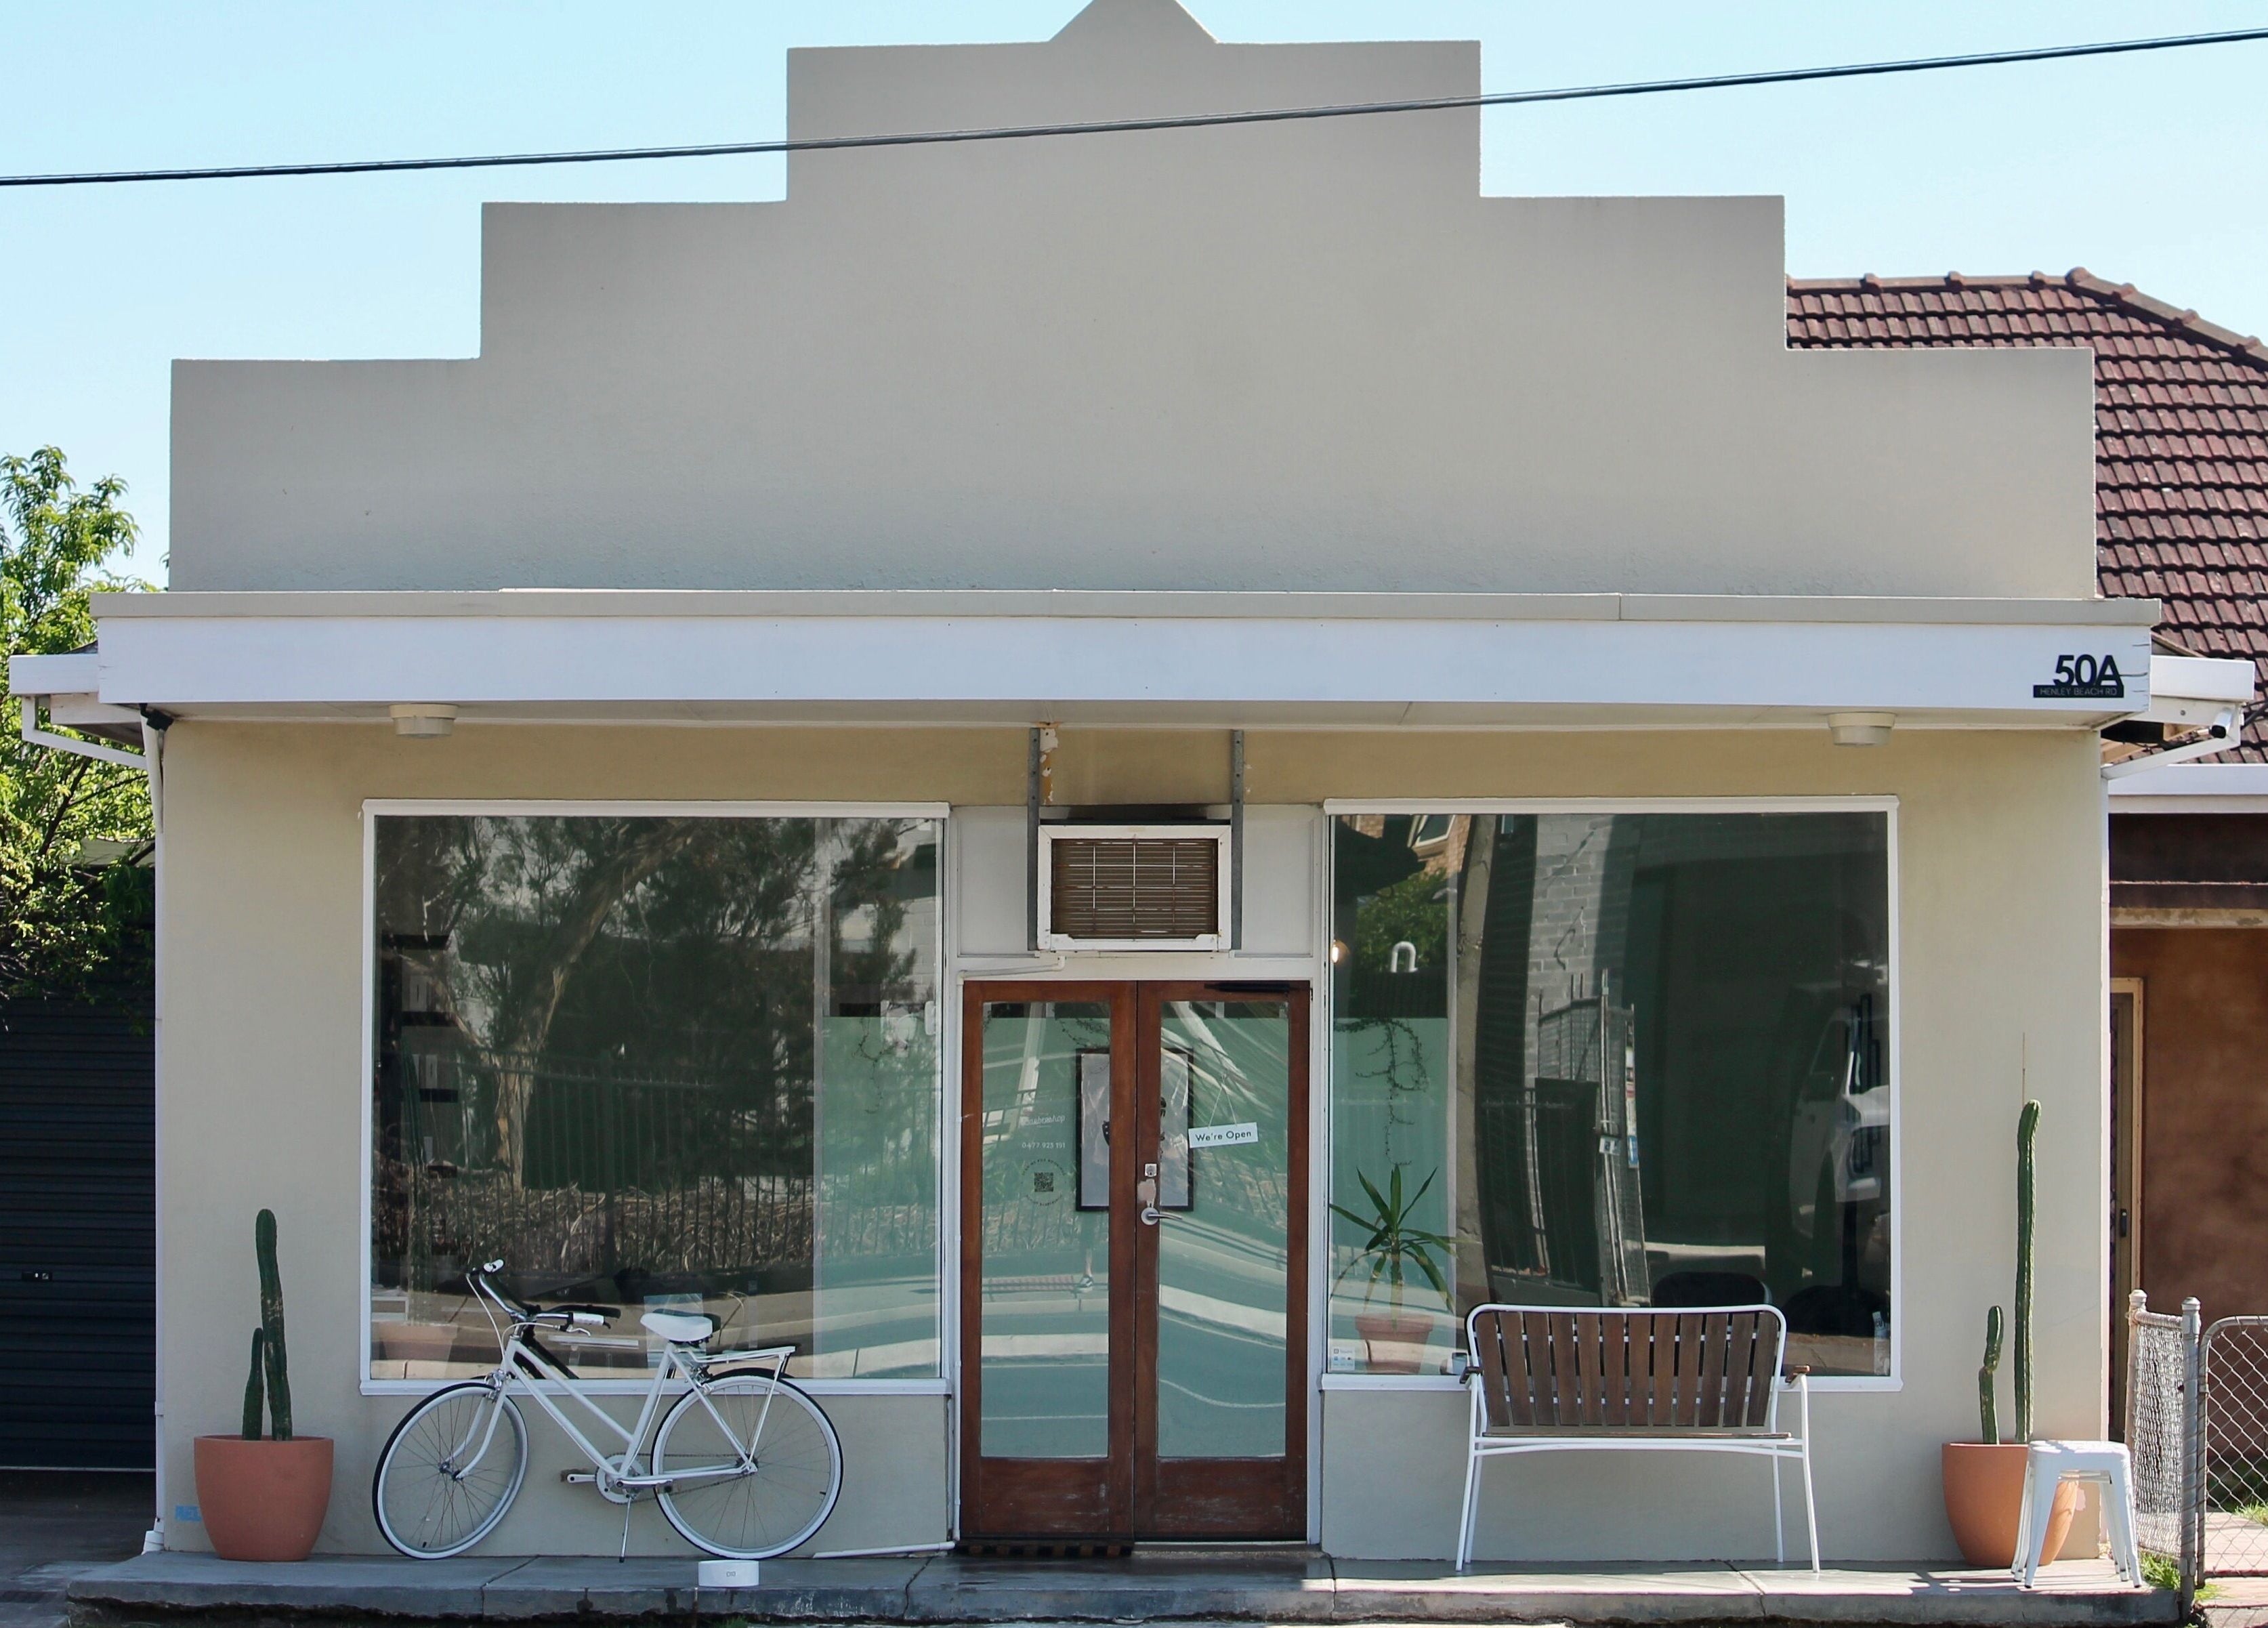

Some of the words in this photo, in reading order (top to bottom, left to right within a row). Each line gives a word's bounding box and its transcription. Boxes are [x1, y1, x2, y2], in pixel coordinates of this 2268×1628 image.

[2053, 654, 2124, 686] 50A
[2040, 688, 2072, 696] HENLEY
[2074, 688, 2103, 696] BEACH
[2105, 688, 2117, 696] RD
[1195, 1133, 1223, 1142] We're
[1225, 1130, 1251, 1141] Open
